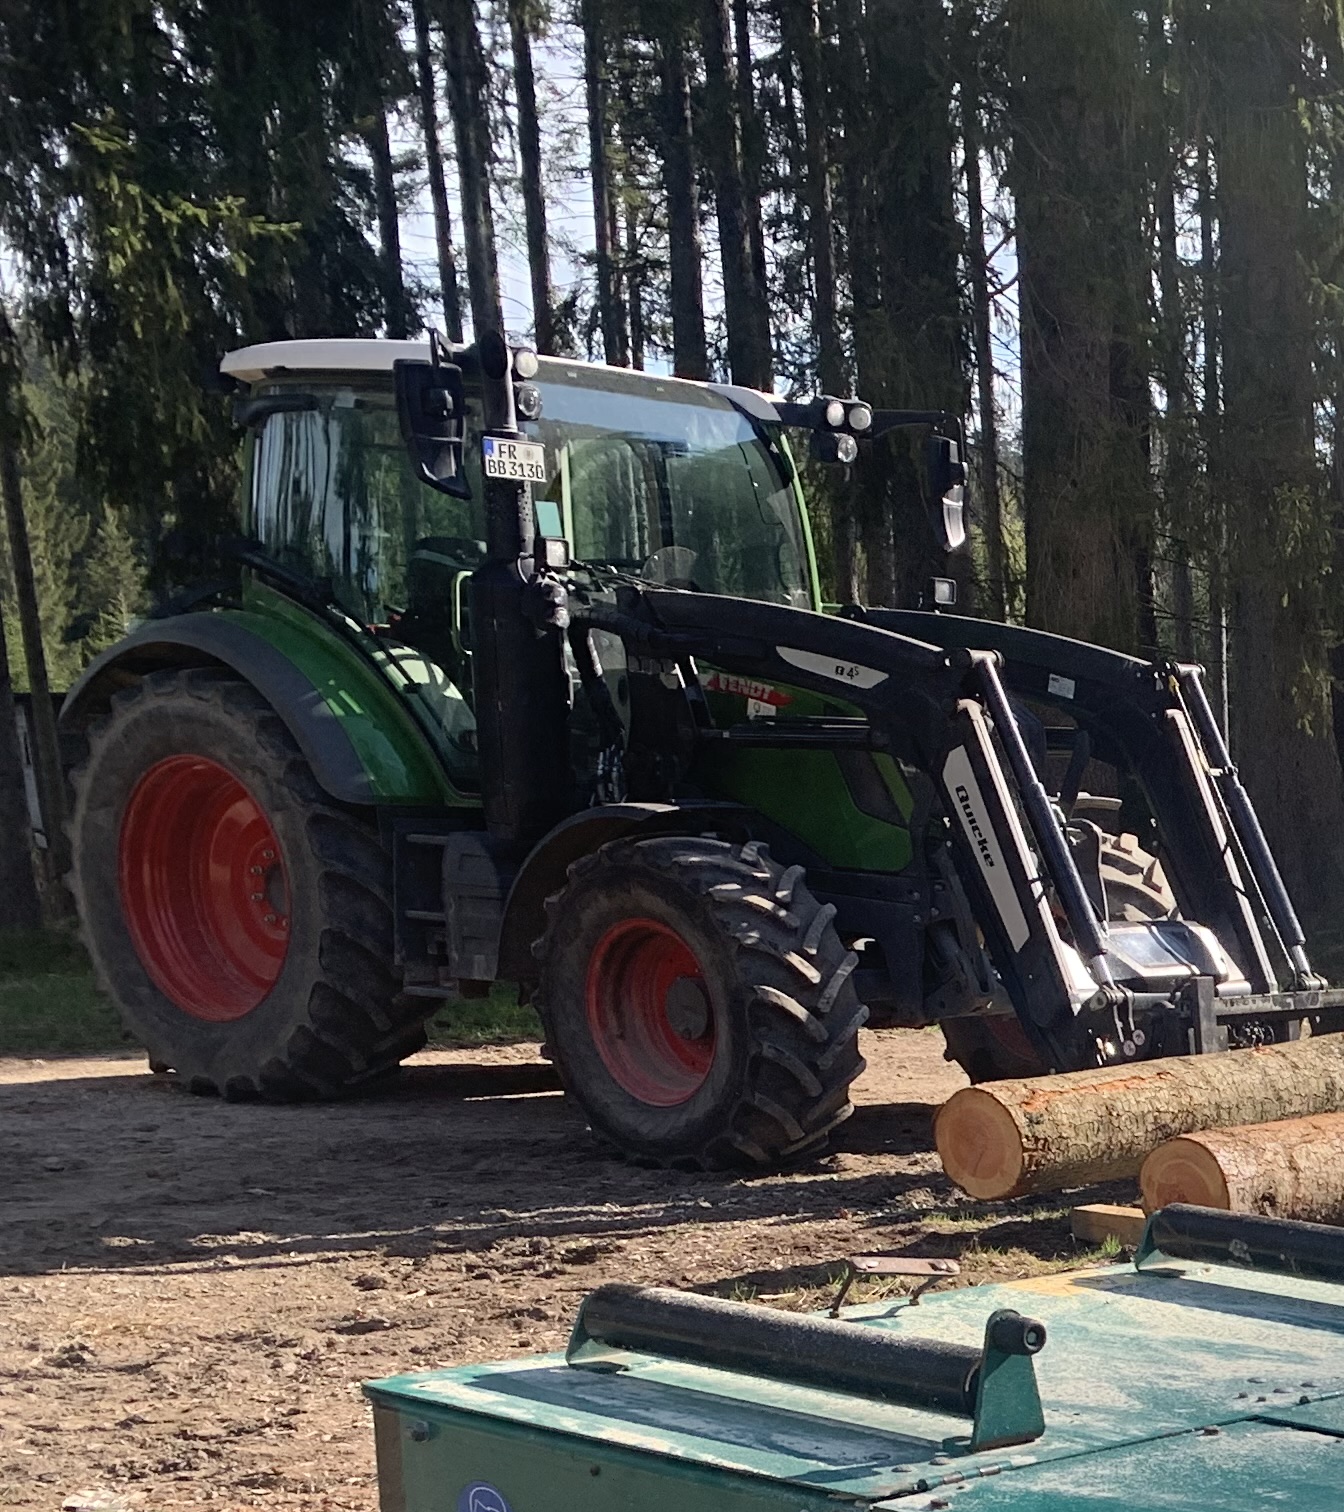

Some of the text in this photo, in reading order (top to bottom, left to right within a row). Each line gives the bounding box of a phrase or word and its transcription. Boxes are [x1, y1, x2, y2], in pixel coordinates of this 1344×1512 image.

[498, 443, 517, 460] FR
[488, 459, 544, 480] BB 3130
[718, 672, 775, 700] FENDT
[955, 785, 995, 868] Quicke
